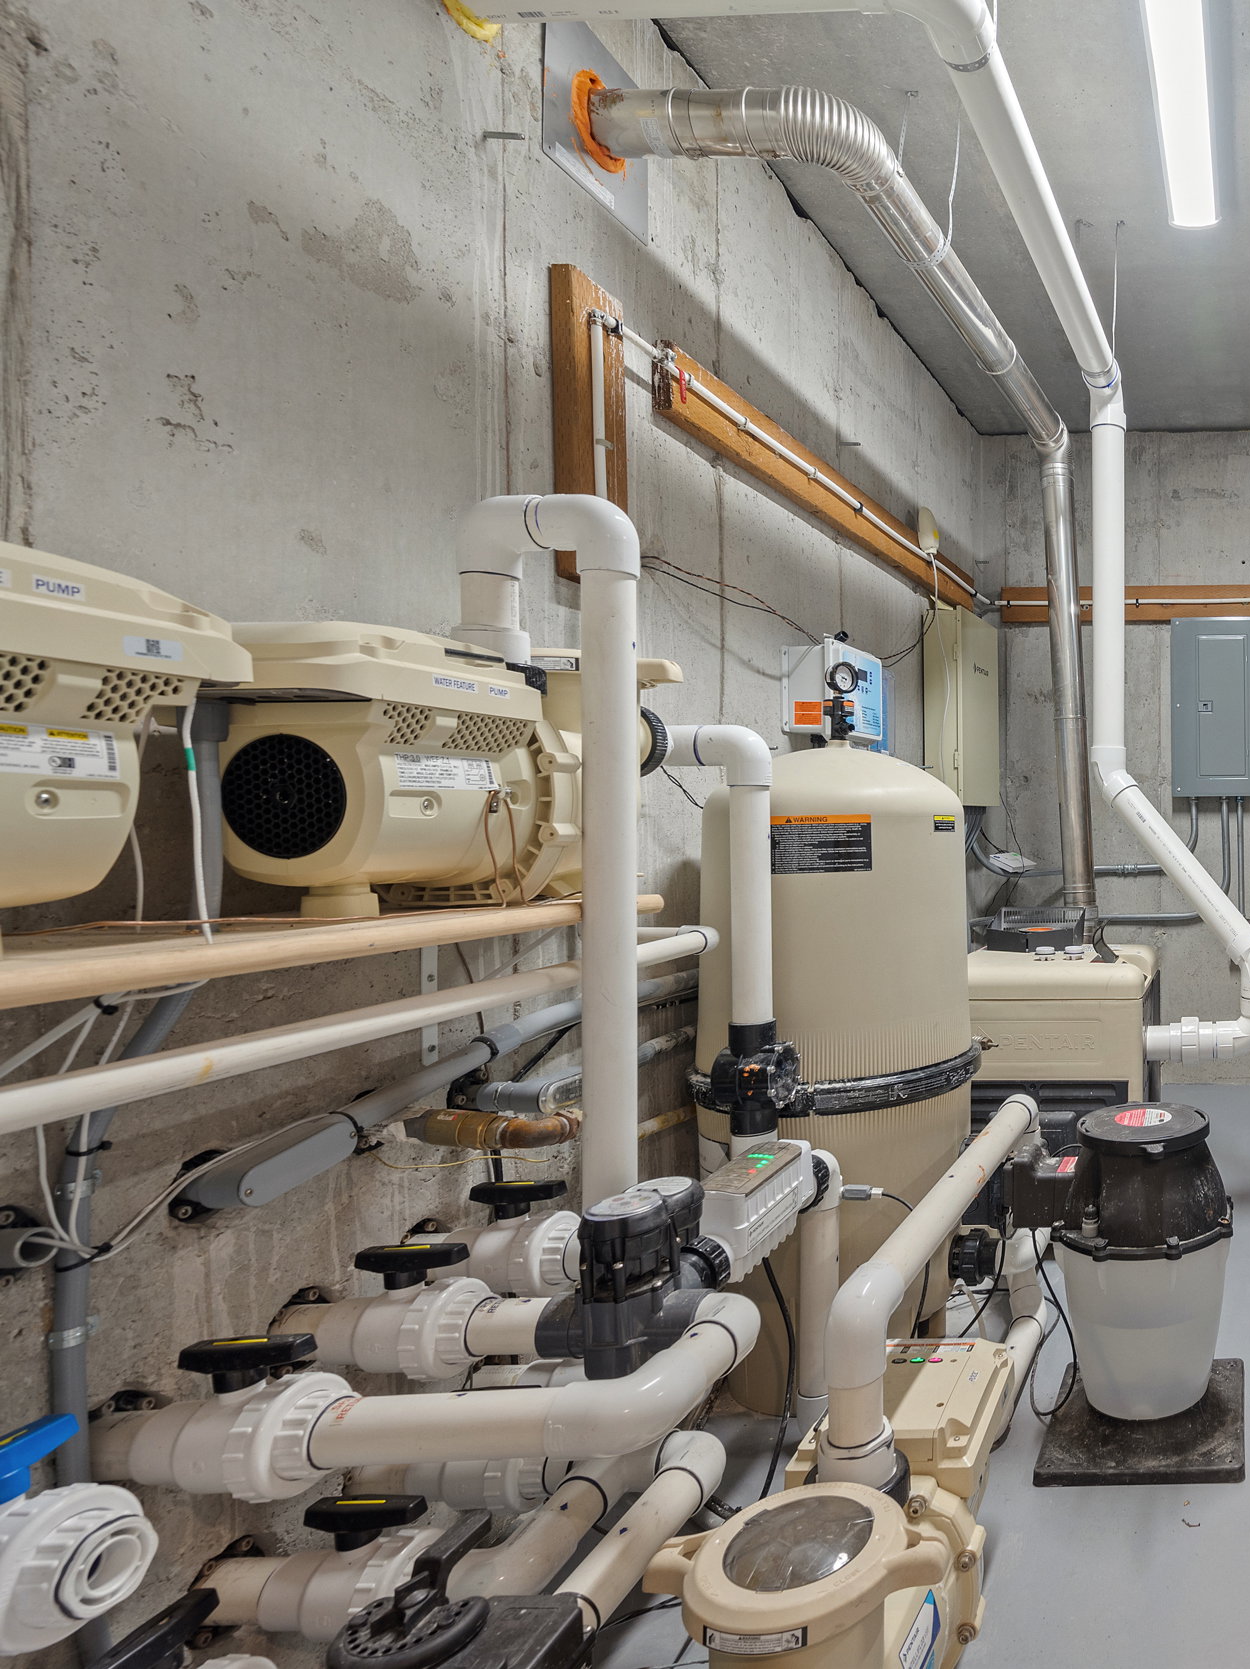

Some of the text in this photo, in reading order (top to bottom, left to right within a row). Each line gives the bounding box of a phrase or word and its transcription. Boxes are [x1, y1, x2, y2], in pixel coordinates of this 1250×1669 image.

[35, 578, 81, 598] PUMP
[434, 676, 476, 692] WATER FEATURE
[489, 686, 509, 697] PUMP
[999, 1033, 1096, 1051] PENTAIR
